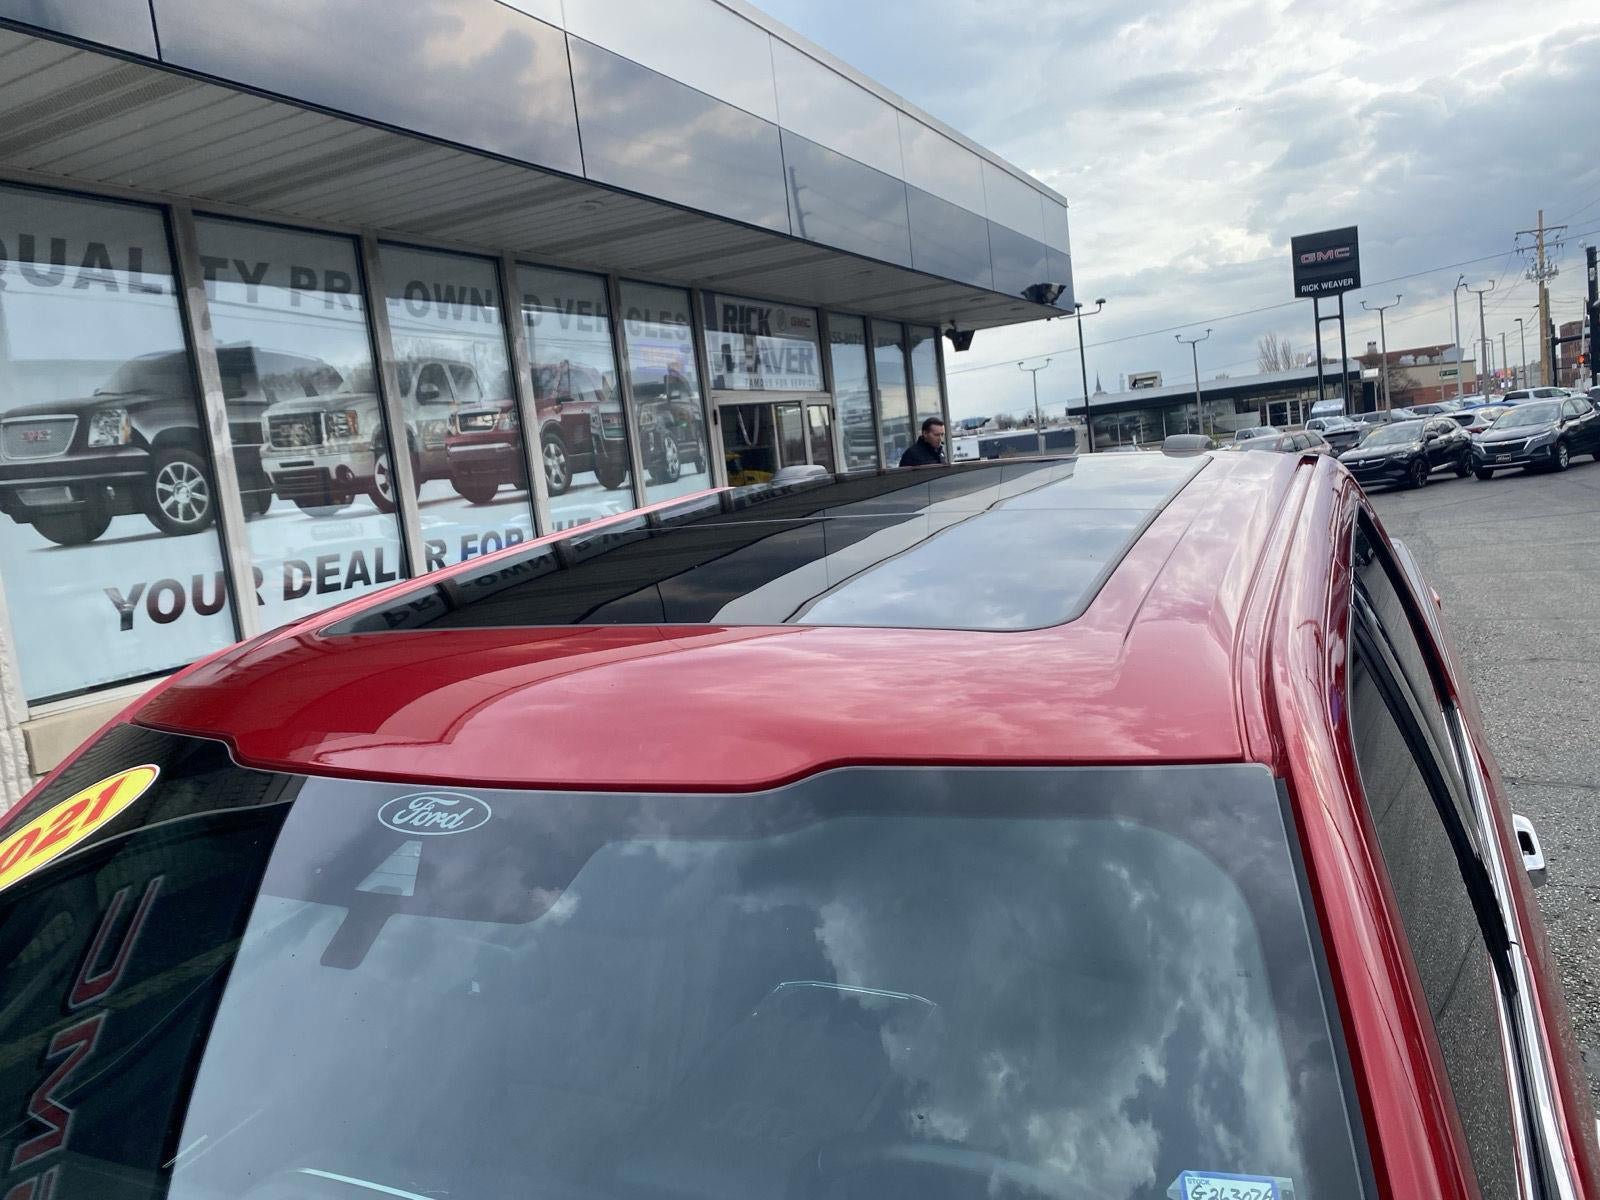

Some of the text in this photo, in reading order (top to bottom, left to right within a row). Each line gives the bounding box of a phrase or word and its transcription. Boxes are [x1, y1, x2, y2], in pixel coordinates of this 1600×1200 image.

[1301, 247, 1350, 264] GMC
[0, 233, 690, 340] UALTY PR-OWND VEHCLES
[1301, 278, 1354, 293] RICK WEAVER
[722, 304, 772, 336] RICK
[283, 539, 447, 600] DEALR
[391, 796, 475, 830] Ford
[1187, 1178, 1211, 1186] STOCK
